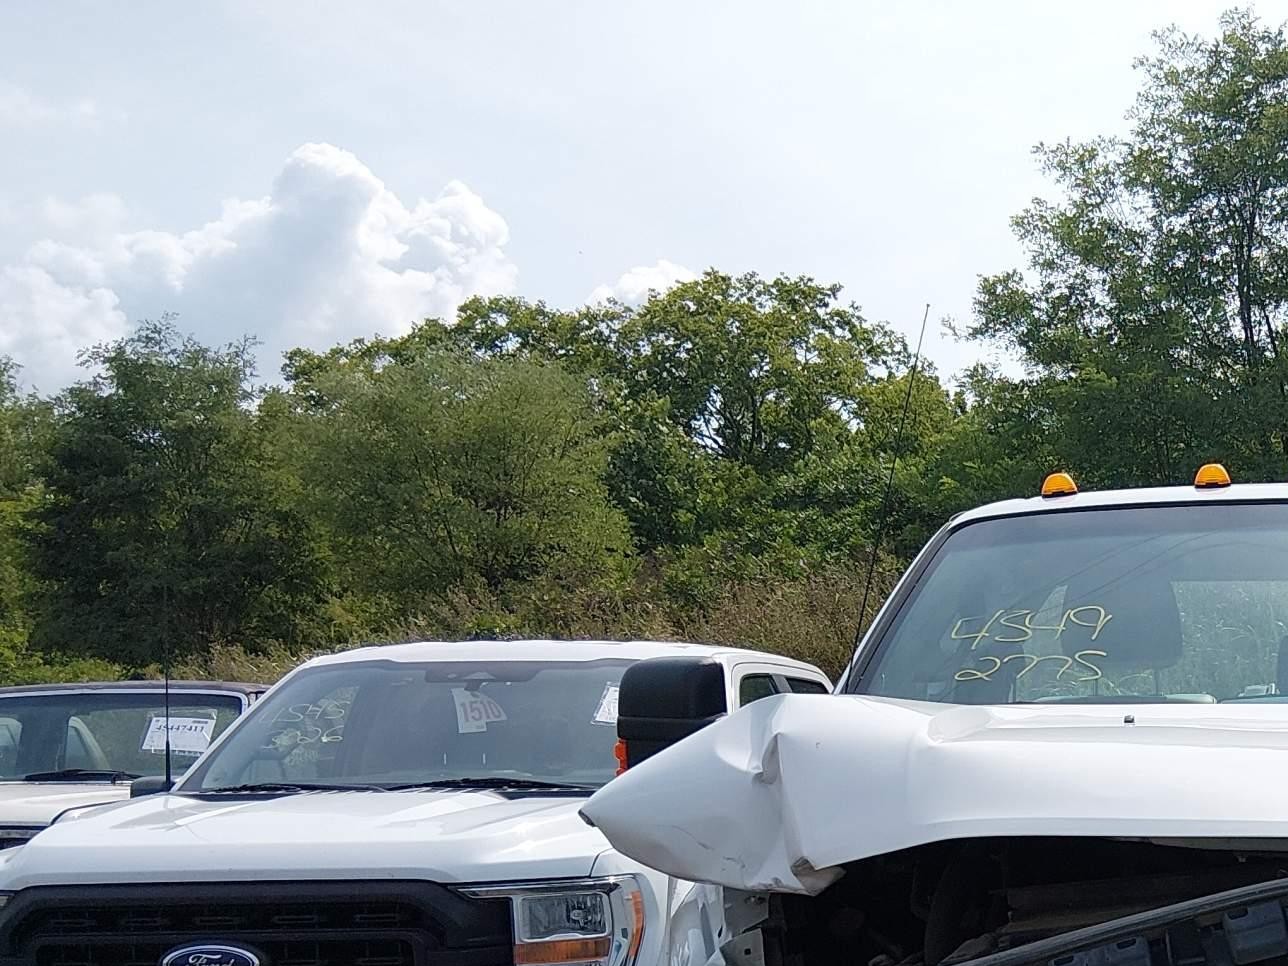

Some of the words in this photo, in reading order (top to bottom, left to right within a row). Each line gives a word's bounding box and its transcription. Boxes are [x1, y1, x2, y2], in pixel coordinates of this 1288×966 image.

[951, 605, 1113, 651] 4549
[954, 650, 1107, 681] 2775
[460, 699, 502, 722] 1510
